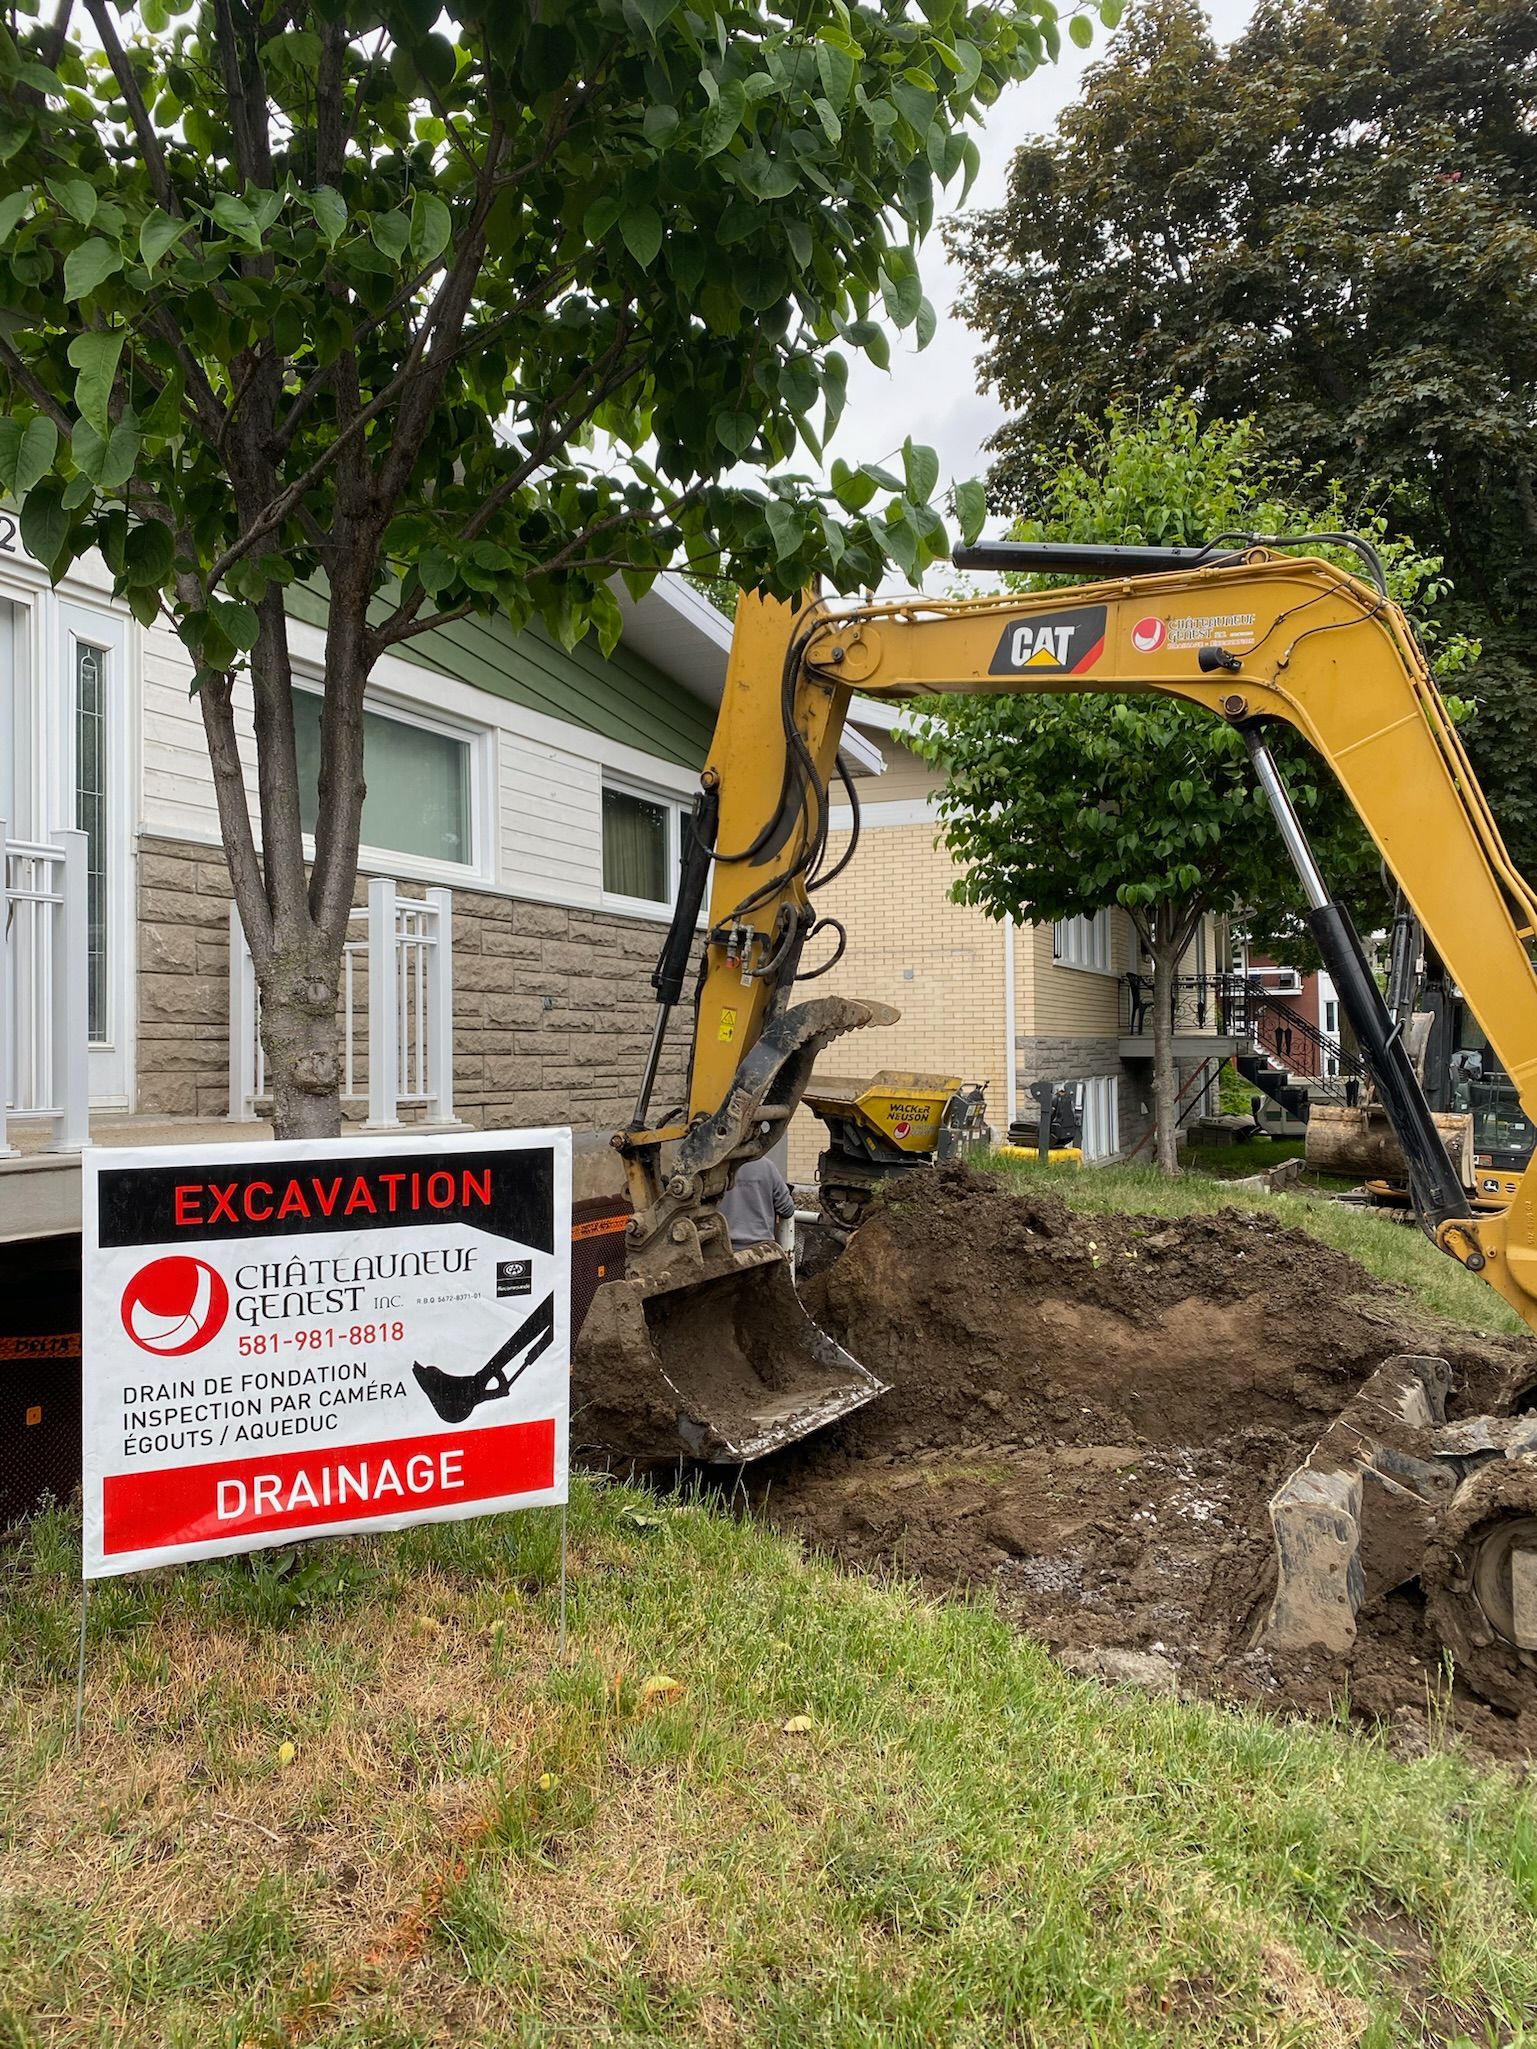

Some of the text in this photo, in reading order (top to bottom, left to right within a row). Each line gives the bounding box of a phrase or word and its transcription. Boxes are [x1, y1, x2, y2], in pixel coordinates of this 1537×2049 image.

[1011, 626, 1075, 666] CAT
[886, 1112, 930, 1121] NEUSON
[175, 1169, 491, 1225] EXCAVATION
[235, 1248, 478, 1290] CHÂTEAUNEUF
[235, 1286, 366, 1327] GENEST
[239, 1321, 404, 1357] 581-981-8818
[123, 1362, 367, 1405] DRAIN DE FONDATION
[124, 1380, 407, 1431] INSPECTION PAR CAMÉRA
[124, 1413, 338, 1456] ÉGOUTS / AQUEDUC
[216, 1449, 465, 1520] DRAINAGE
